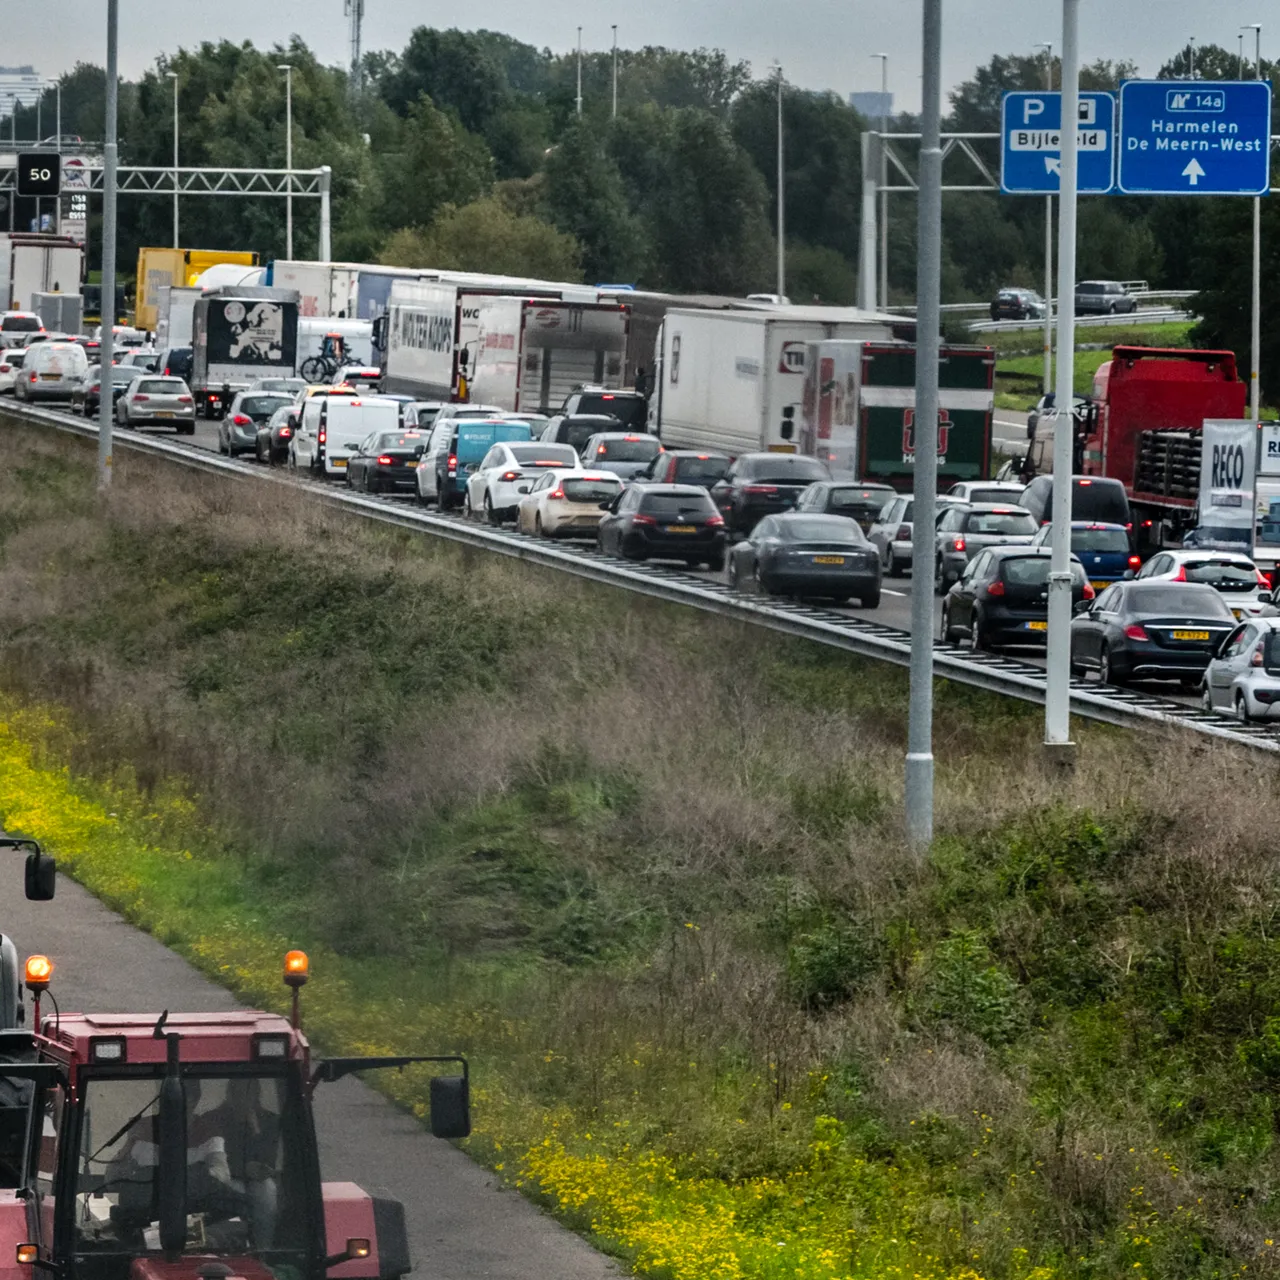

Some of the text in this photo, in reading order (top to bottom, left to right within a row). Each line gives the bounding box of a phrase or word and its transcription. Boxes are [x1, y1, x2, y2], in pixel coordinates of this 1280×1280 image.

[1195, 95, 1222, 108] 14a
[1023, 98, 1045, 125] P
[1150, 119, 1239, 134] Harmelen
[1017, 132, 1098, 150] Bijleld
[1127, 137, 1262, 152] De Meern-West
[30, 168, 51, 181] 50
[1211, 444, 1244, 489] RECO
